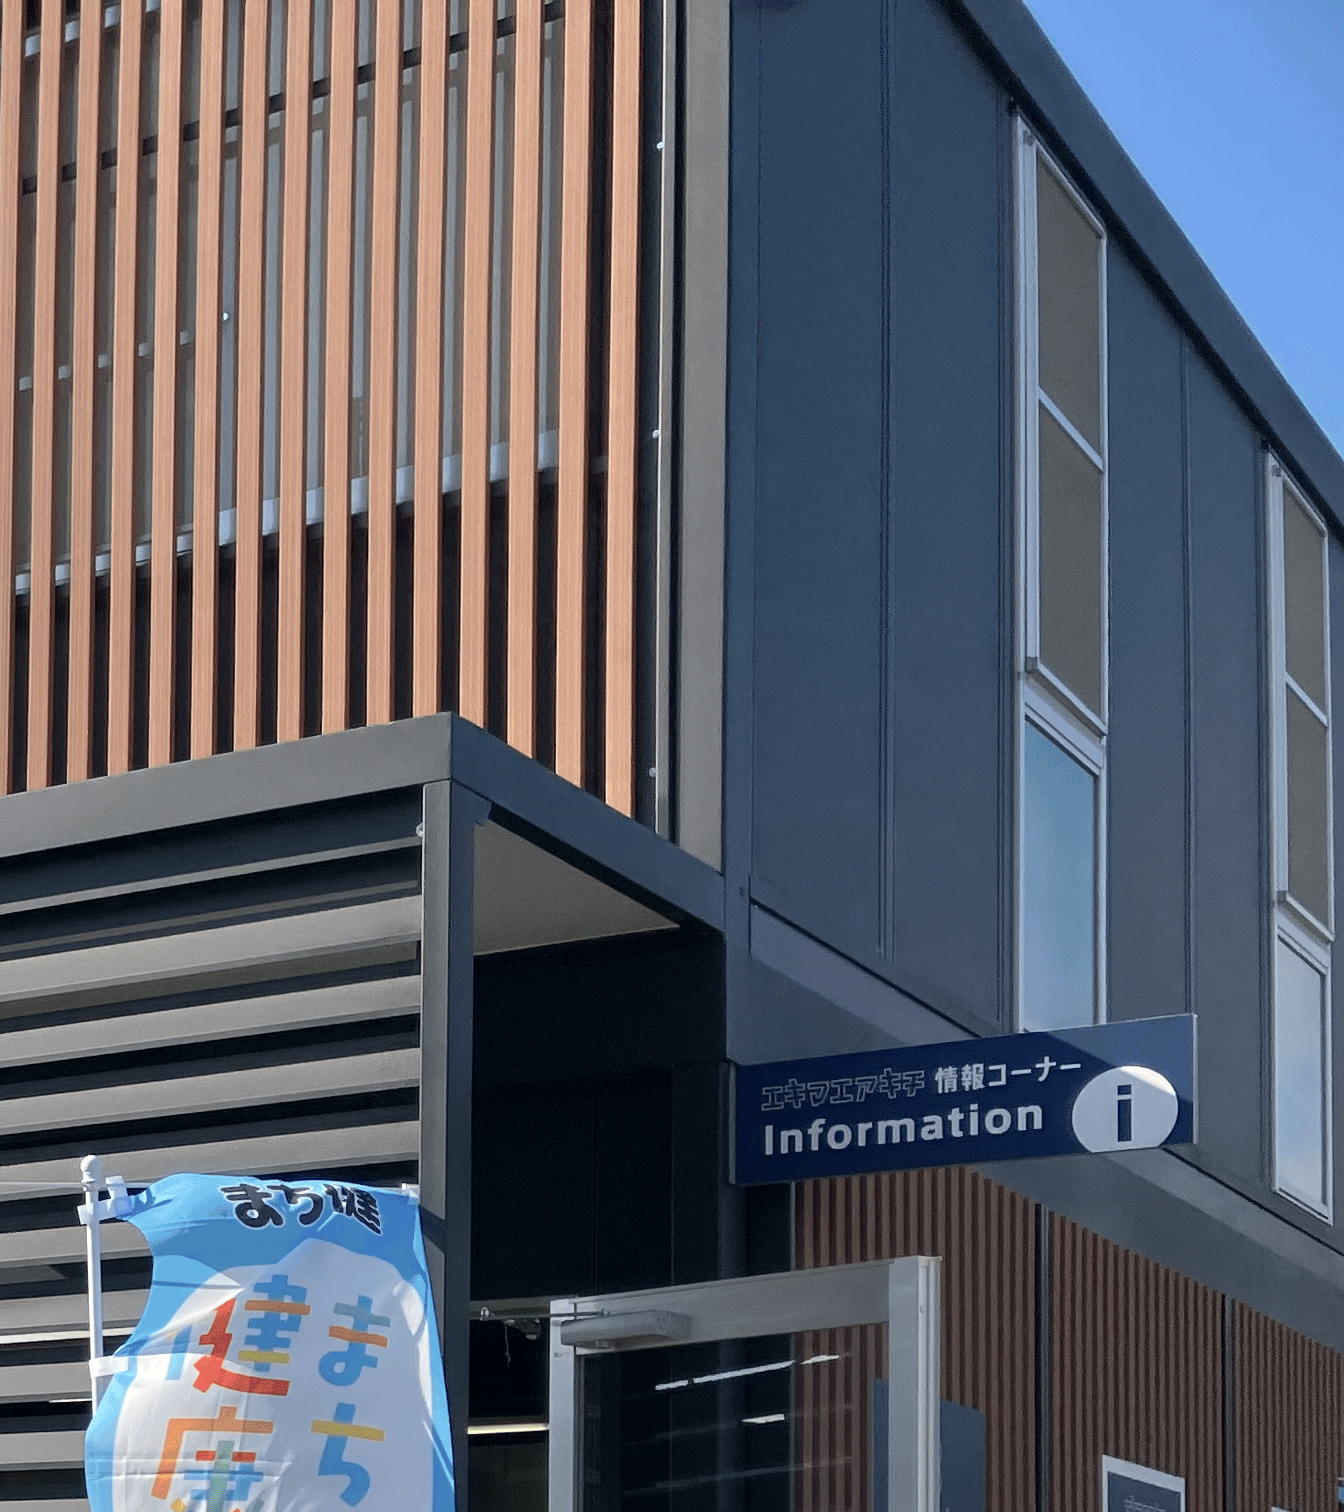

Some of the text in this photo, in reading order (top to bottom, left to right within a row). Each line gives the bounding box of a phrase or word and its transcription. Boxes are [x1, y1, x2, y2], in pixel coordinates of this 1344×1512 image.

[934, 1056, 1082, 1095] 情報コーナー
[764, 1101, 1044, 1156] Information
